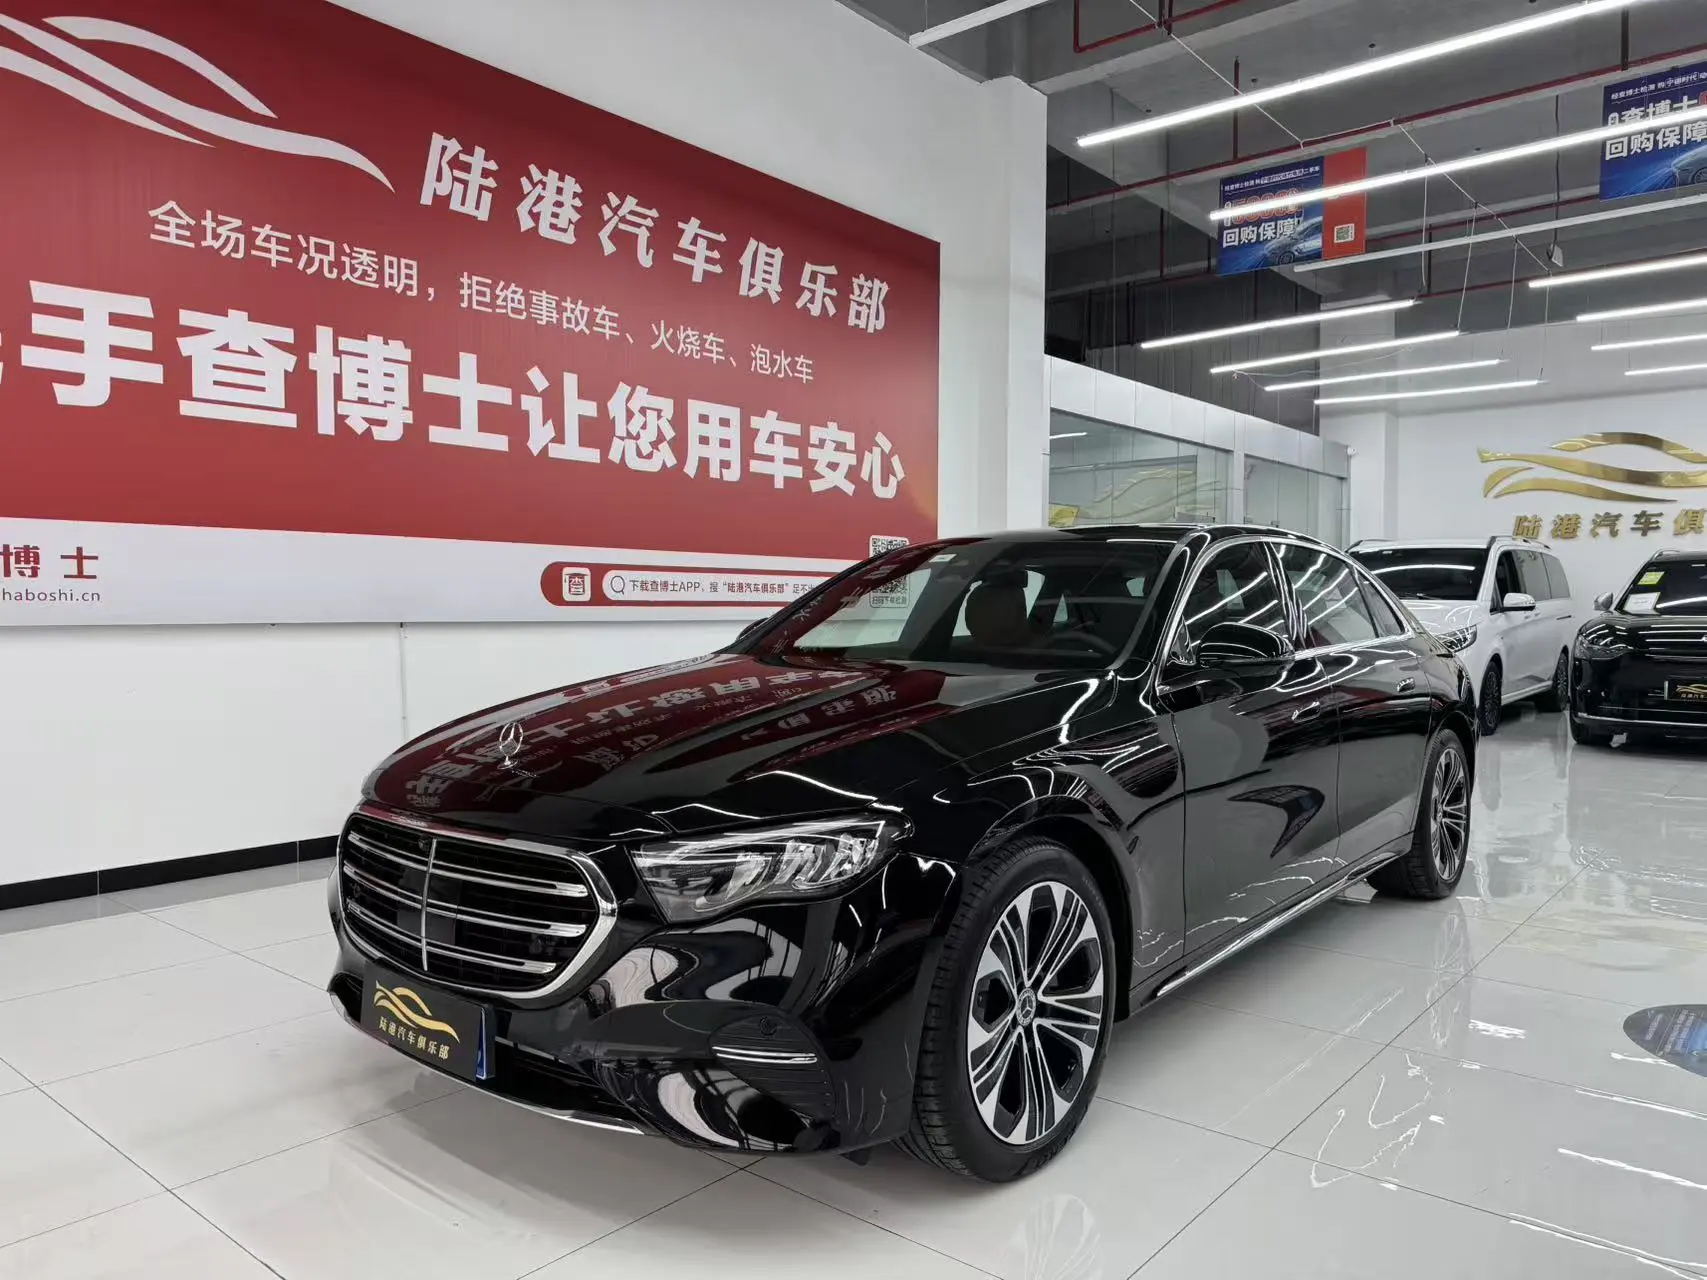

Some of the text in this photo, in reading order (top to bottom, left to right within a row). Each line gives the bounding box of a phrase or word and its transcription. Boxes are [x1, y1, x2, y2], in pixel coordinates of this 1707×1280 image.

[1605, 120, 1707, 160] 回购保障
[420, 131, 889, 334] 陆港汽车俱乐部
[1223, 216, 1295, 248] 回购保障
[0, 280, 906, 500] 手查博士让您用车安心
[1513, 508, 1706, 539] 陆港汽车俱
[2, 587, 101, 602] haboshi.cn
[378, 1015, 450, 1060] 陆港汽车俱乐部
